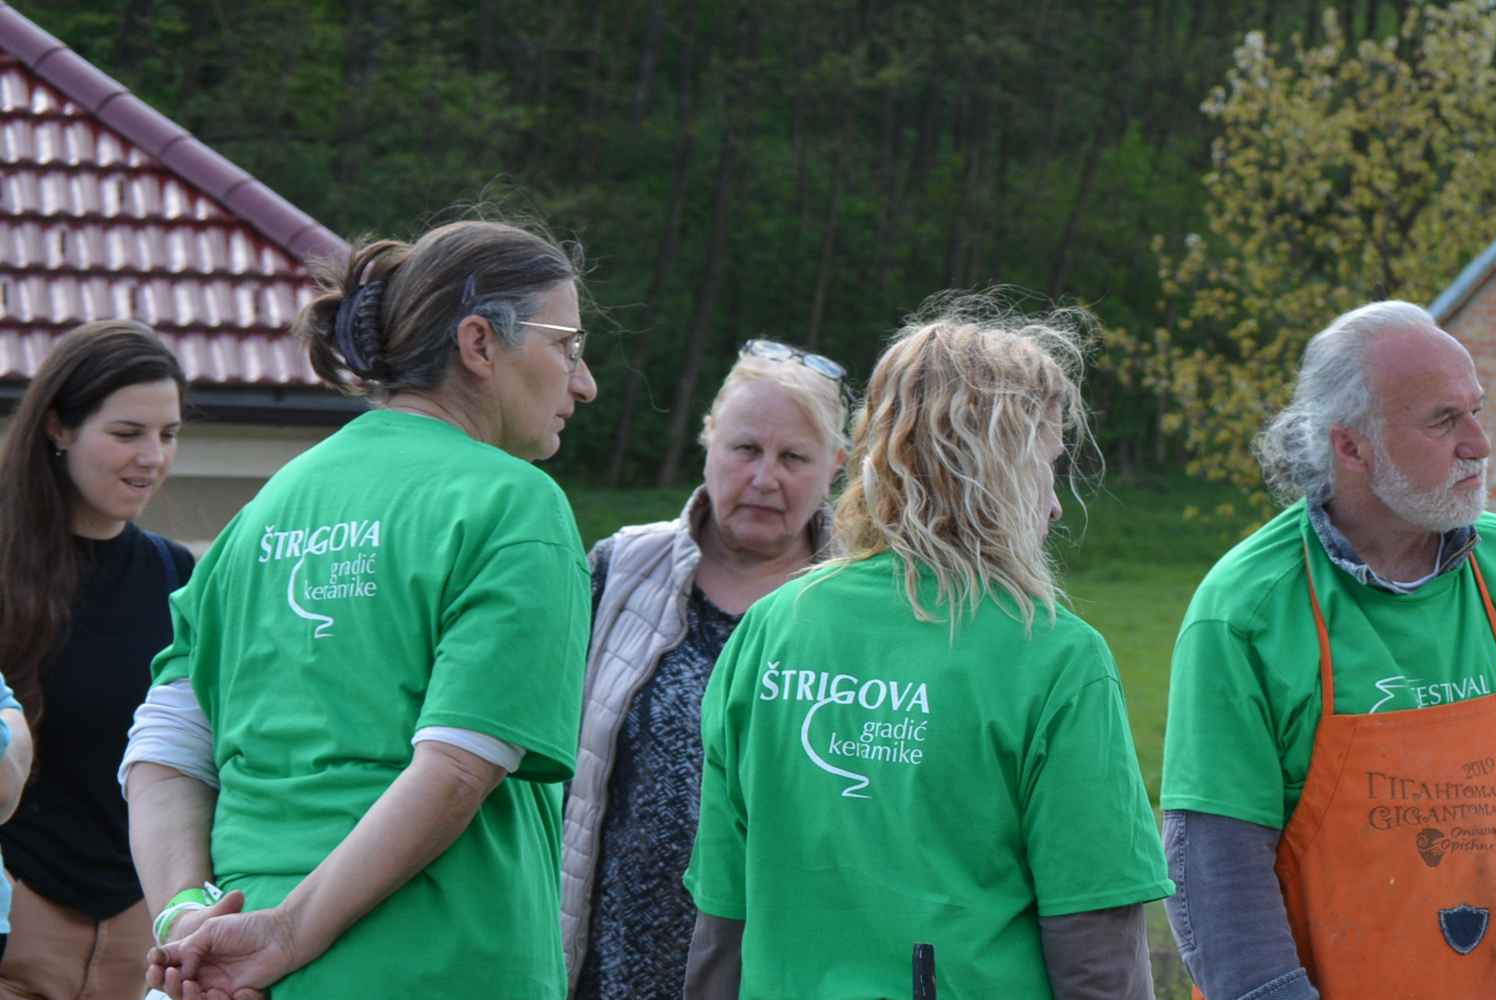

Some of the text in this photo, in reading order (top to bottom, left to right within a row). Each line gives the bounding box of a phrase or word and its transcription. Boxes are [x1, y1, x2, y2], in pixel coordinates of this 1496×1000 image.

[258, 519, 380, 563] ŠTRIGOVA
[303, 575, 377, 601] keramike
[759, 660, 930, 714] ŠTRIGOVA
[859, 717, 928, 743] gradić
[828, 732, 923, 765] keramike
